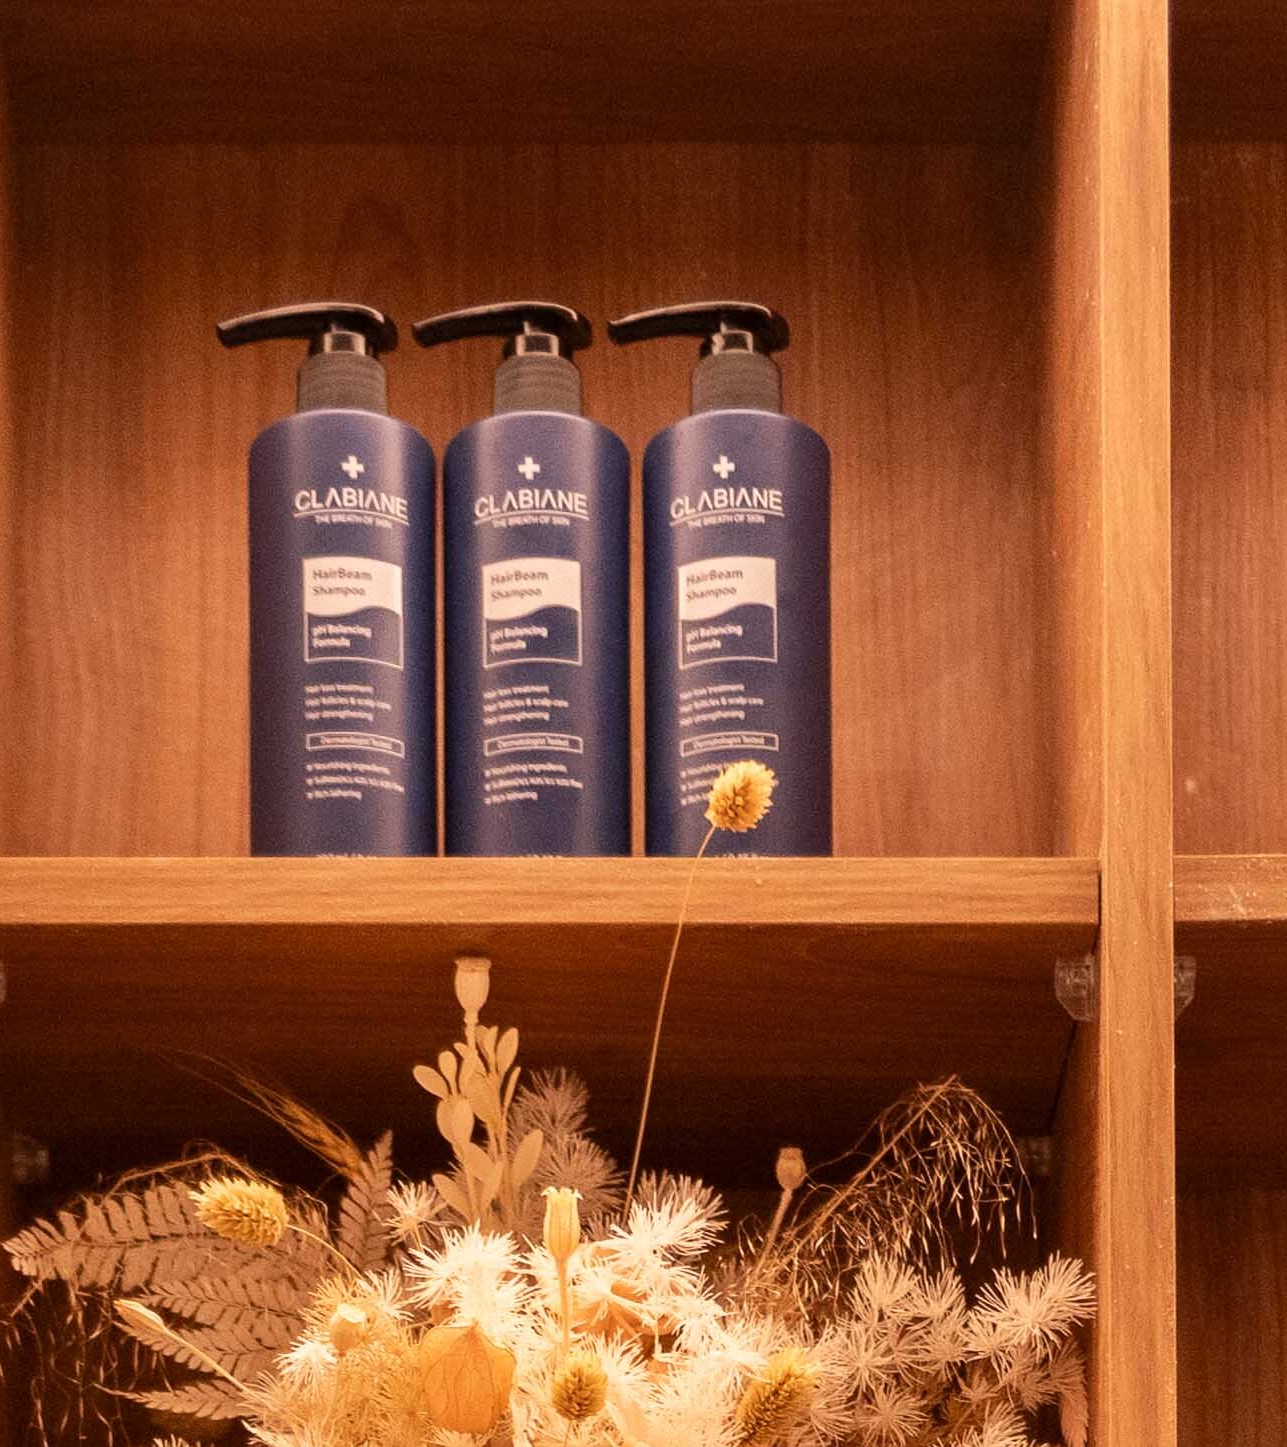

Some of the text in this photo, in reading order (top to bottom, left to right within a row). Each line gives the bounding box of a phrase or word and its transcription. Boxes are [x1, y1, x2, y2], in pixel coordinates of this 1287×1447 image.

[295, 489, 408, 519] CLABIANE
[474, 489, 588, 517] CLABIANE
[671, 488, 783, 519] CLABIANE
[312, 567, 373, 581] HairBeam
[490, 570, 549, 586] HairBeam
[686, 569, 744, 587] HairBeam
[312, 585, 366, 597] Shampoo
[490, 587, 543, 602] Shampoo
[685, 586, 737, 603] Shampoo
